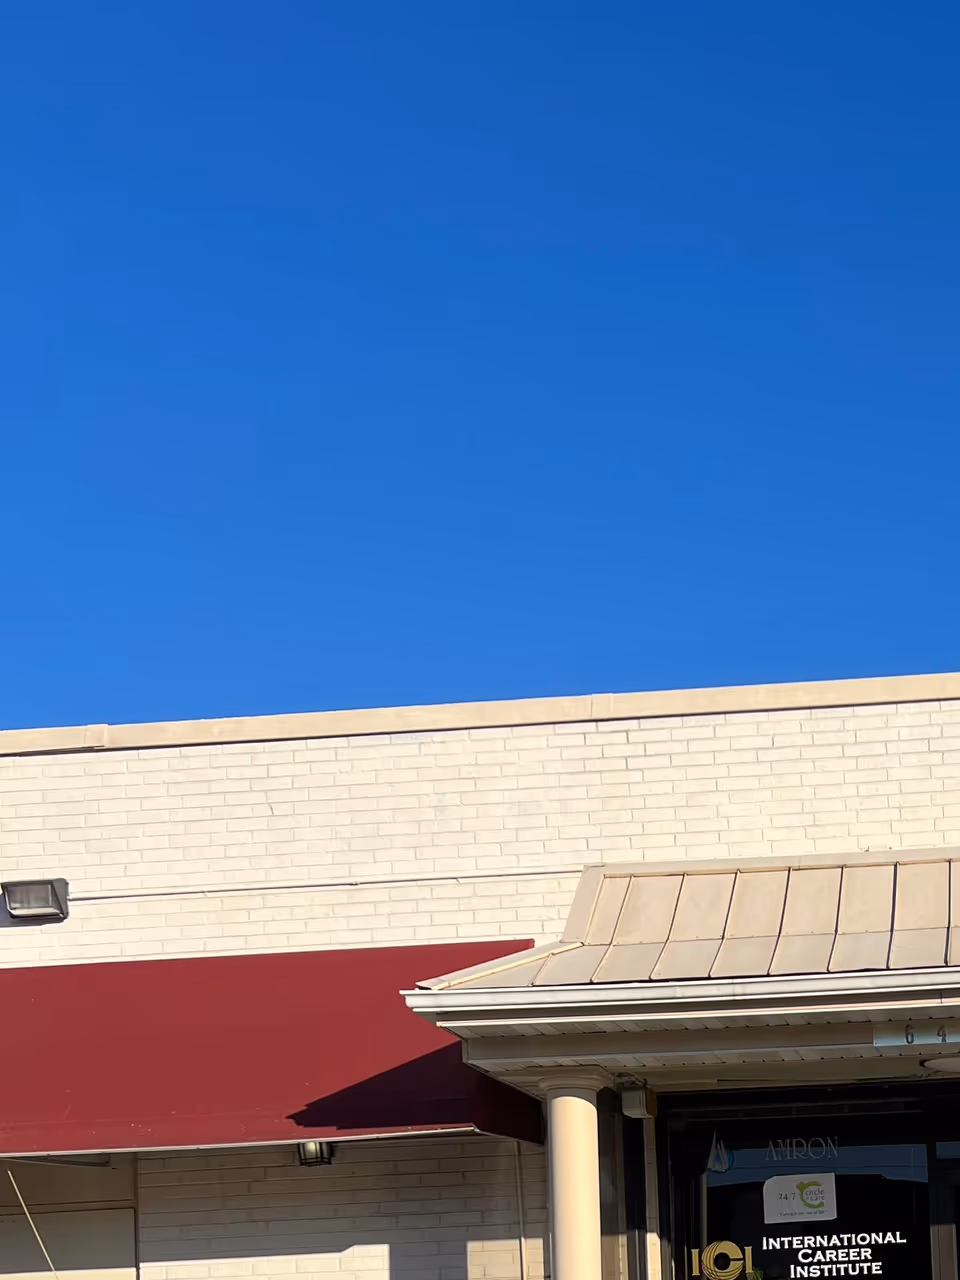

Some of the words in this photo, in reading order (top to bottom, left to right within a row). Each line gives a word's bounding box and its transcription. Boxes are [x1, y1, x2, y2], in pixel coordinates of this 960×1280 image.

[765, 1136, 839, 1161] AMRON
[805, 1188, 824, 1196] circle
[762, 1231, 907, 1250] INTERNATIONAL
[797, 1248, 872, 1264] CAREER
[789, 1261, 883, 1279] INSTITUTE
